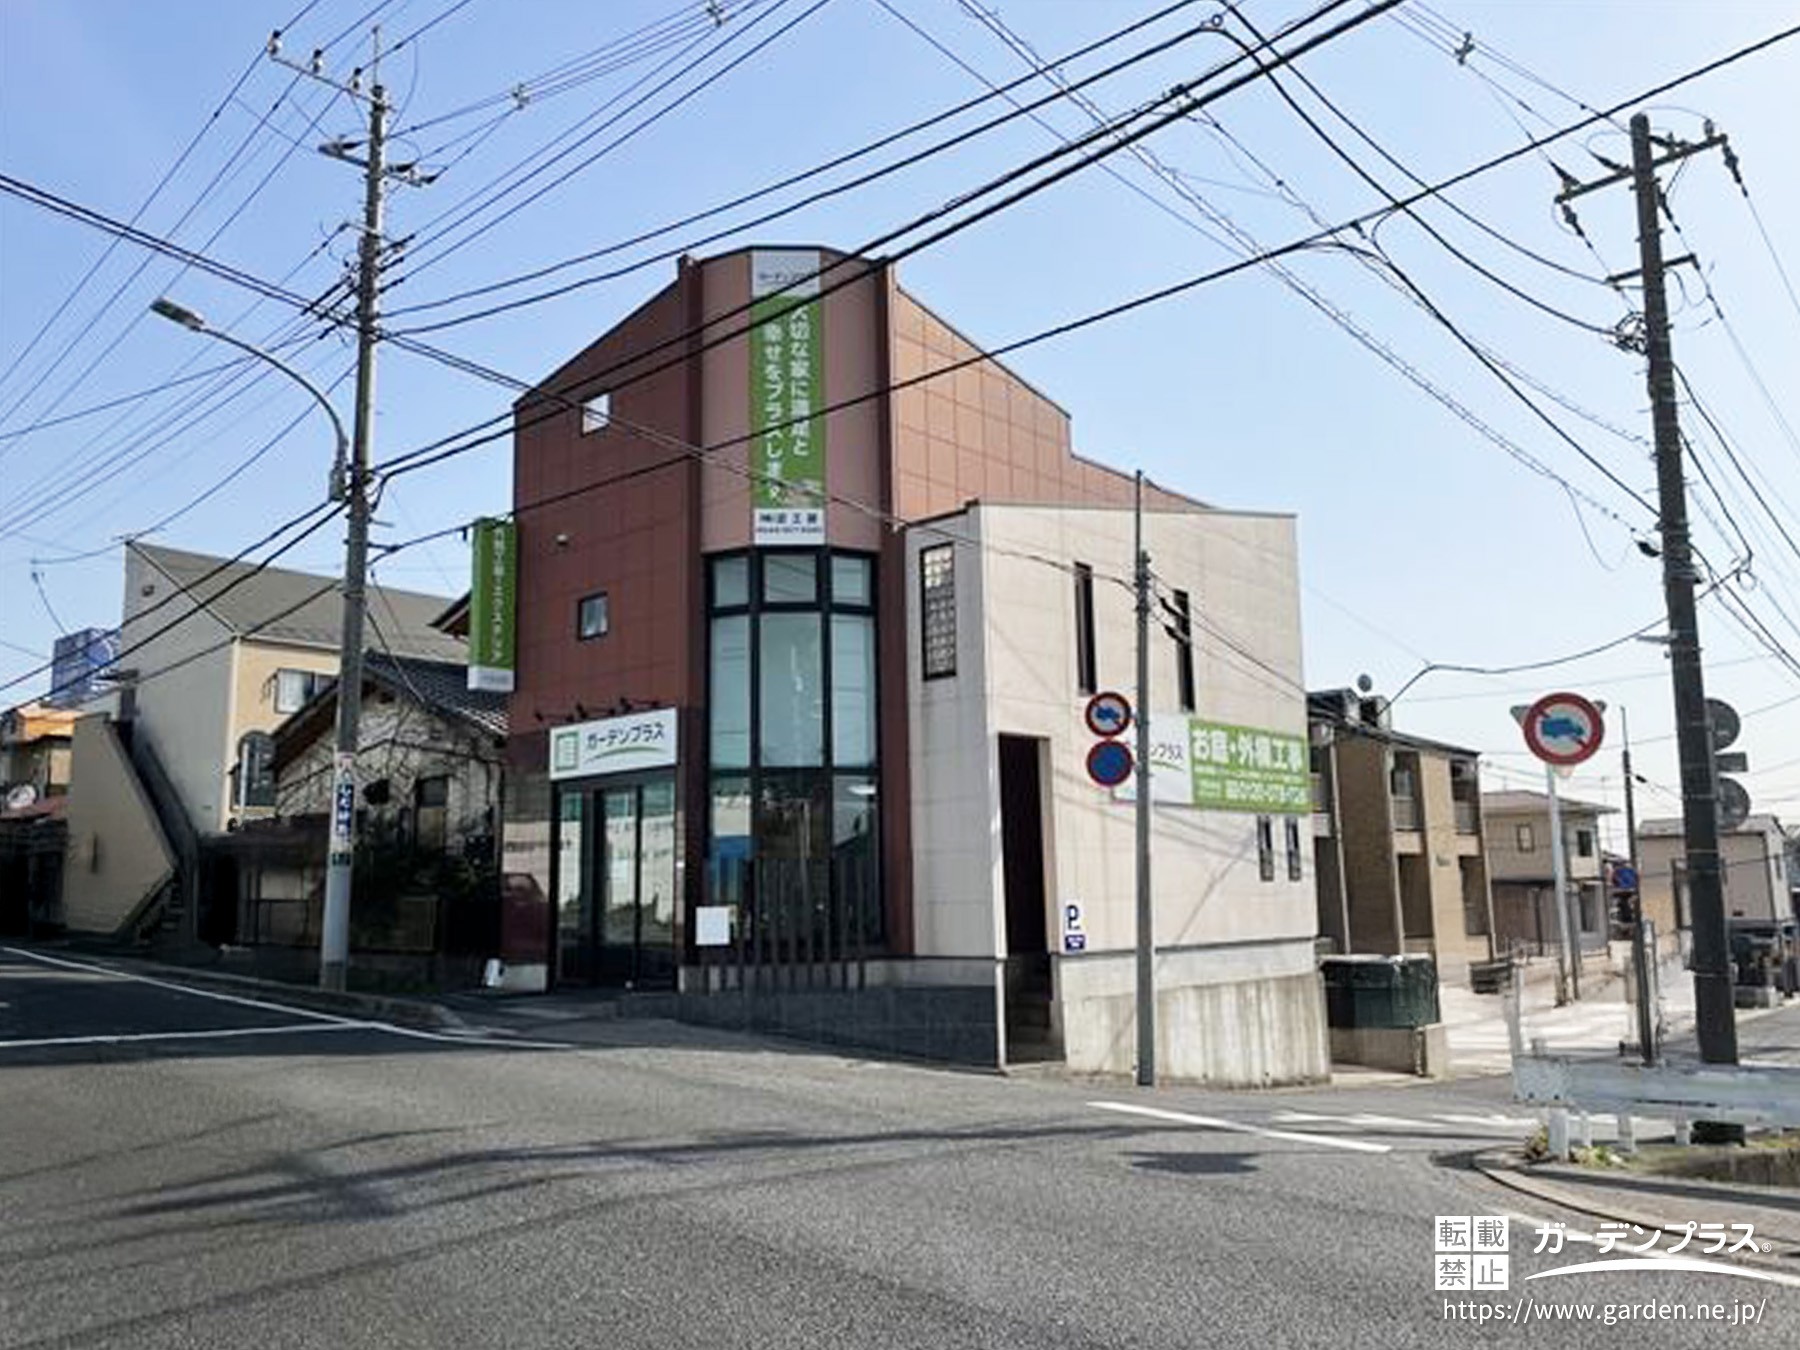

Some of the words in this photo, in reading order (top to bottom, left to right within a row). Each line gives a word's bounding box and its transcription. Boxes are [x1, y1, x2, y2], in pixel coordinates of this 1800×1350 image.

[587, 722, 664, 750] ガーデンプラス
[1066, 904, 1079, 930] P
